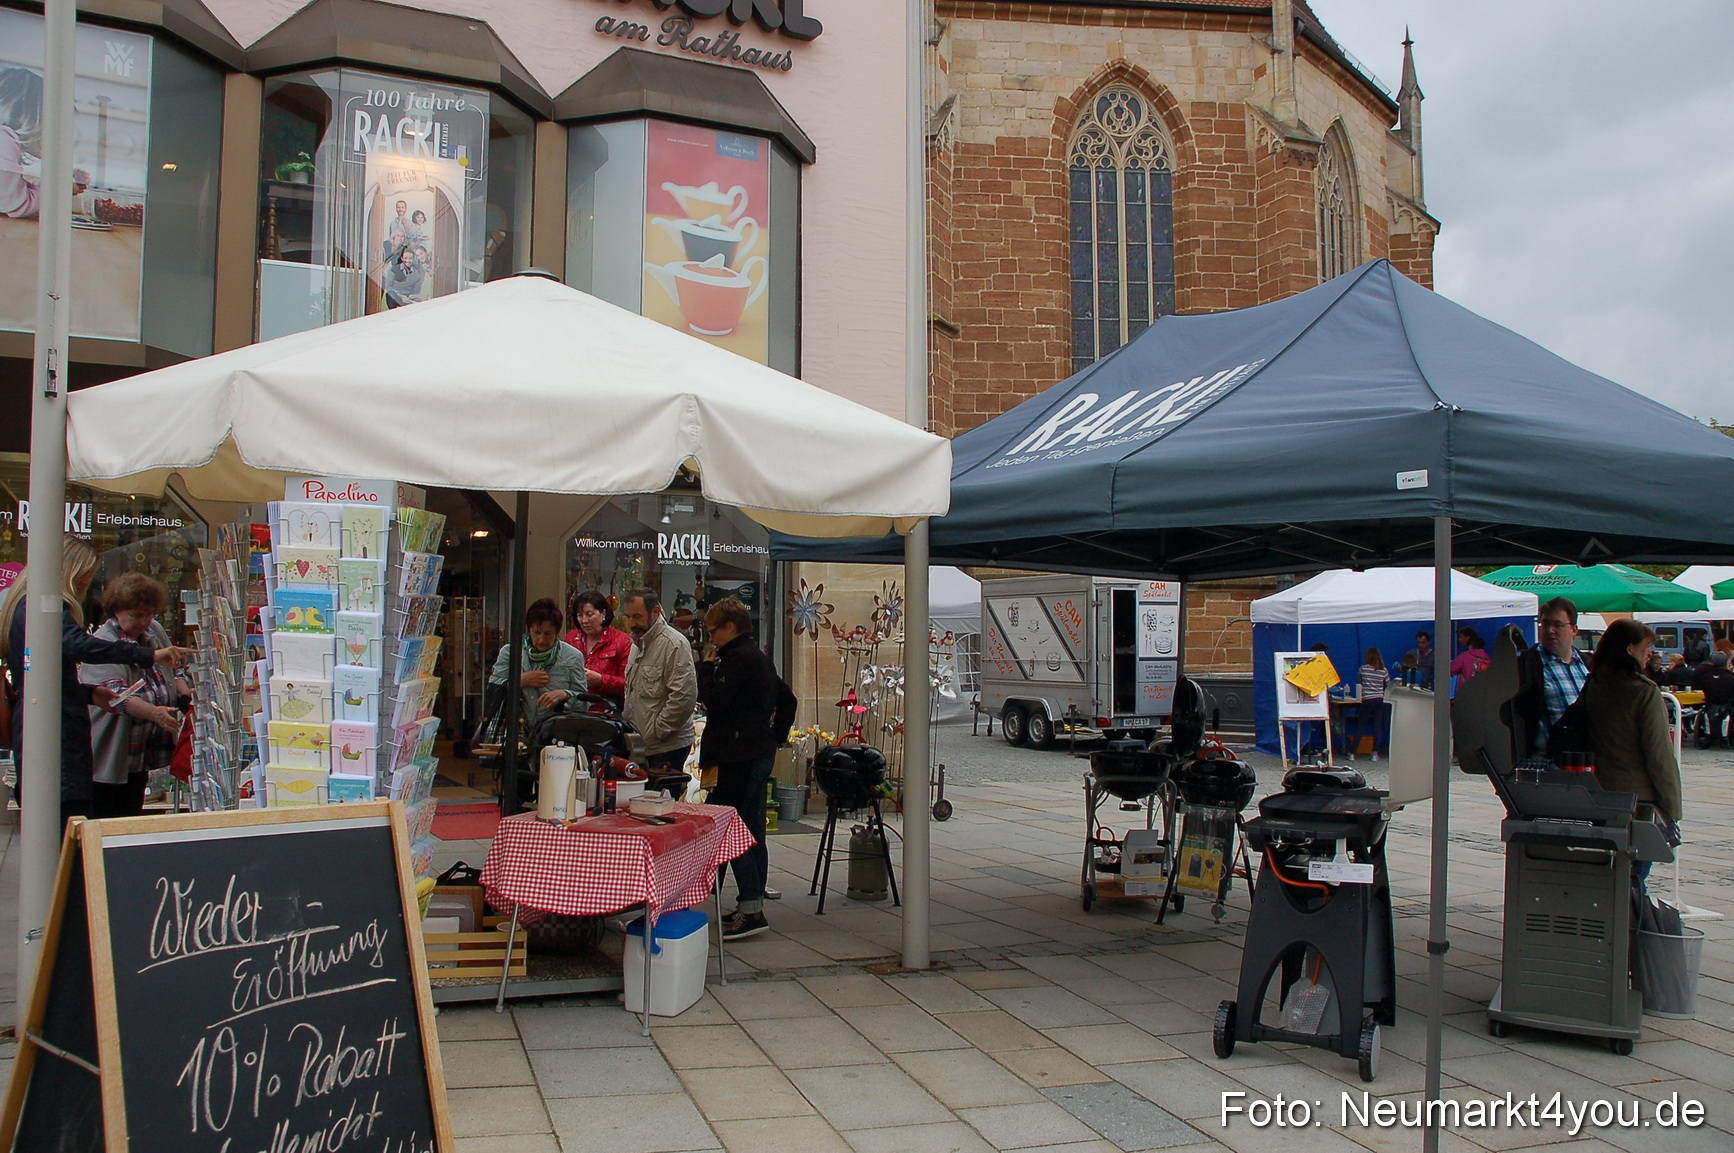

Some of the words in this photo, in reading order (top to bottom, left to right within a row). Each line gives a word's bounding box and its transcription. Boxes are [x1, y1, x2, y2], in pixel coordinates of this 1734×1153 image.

[104, 40, 135, 77] WMF
[594, 15, 650, 42] am
[656, 14, 794, 72] Rathaus
[363, 89, 400, 108] 100
[403, 91, 465, 112] Jahre
[1005, 364, 1249, 456] RACKL
[985, 454, 1041, 469] Jeden
[1041, 449, 1075, 461] Tag
[302, 480, 378, 503] Papelino
[18, 500, 92, 533] RKL
[97, 513, 185, 528] Erlebnishaus.
[575, 538, 640, 550] Willkommen
[641, 540, 654, 550] im
[657, 532, 711, 561] RACKL
[713, 543, 770, 555] Erlebnishau
[1143, 589, 1173, 599] Spülmobil
[1149, 582, 1166, 591] CAH
[1053, 602, 1081, 647] Spülmobil
[1064, 599, 1082, 629] CAH
[150, 874, 263, 960] Wieder
[231, 918, 388, 1013] Eröffnung
[287, 1016, 407, 1107] Rabatt
